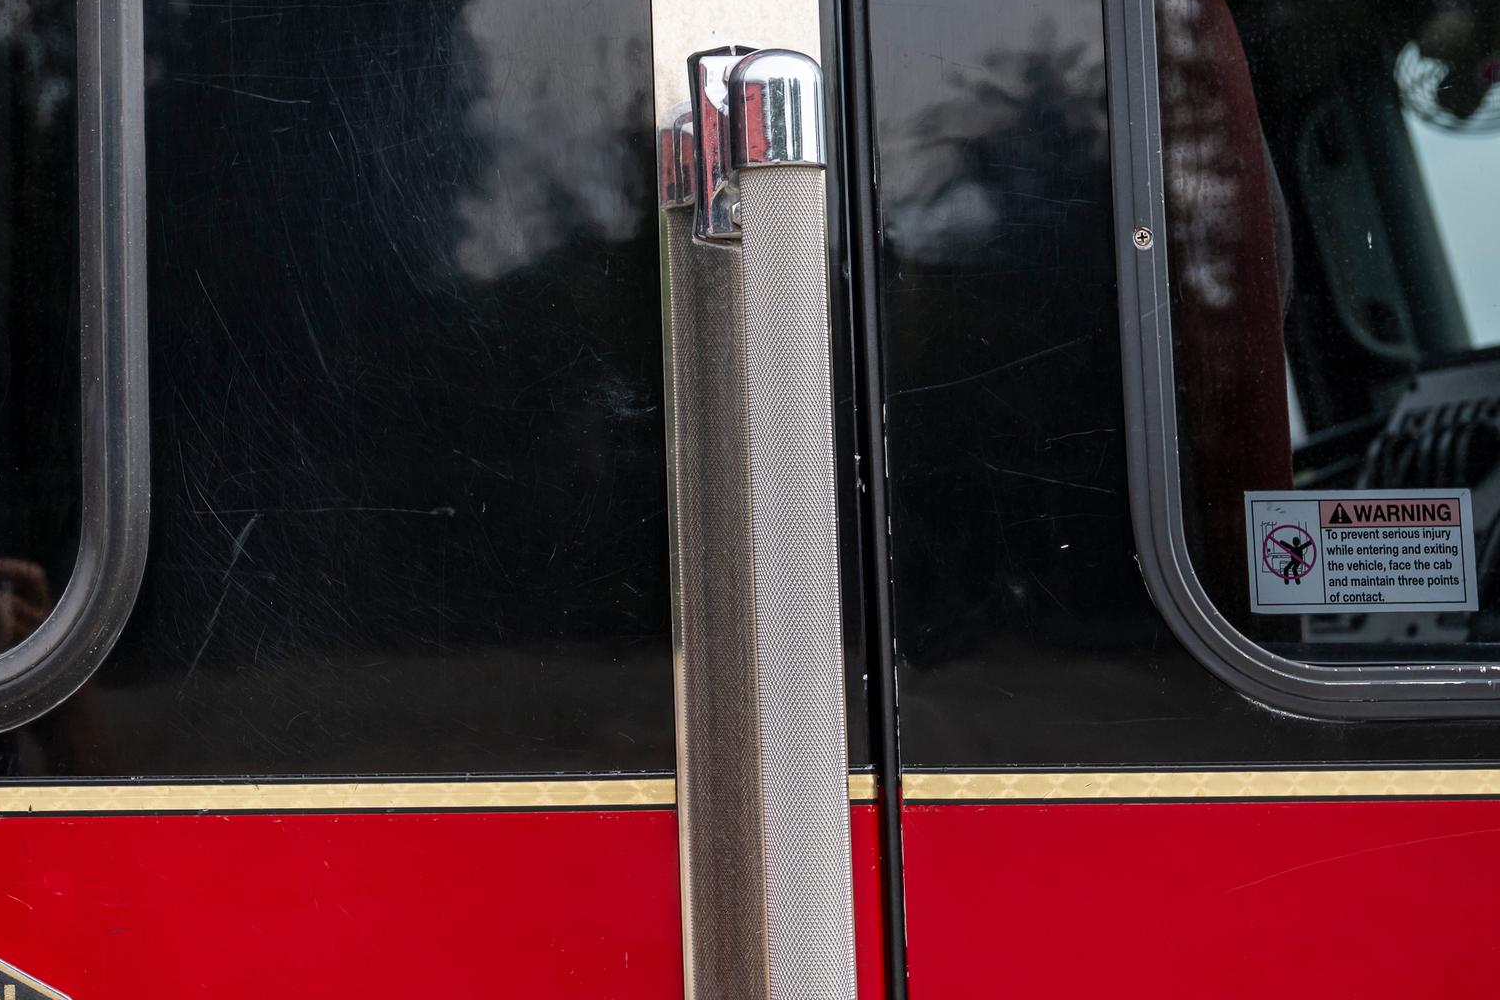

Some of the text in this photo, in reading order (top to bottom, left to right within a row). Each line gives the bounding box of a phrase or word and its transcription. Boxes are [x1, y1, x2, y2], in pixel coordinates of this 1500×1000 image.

[1353, 504, 1451, 522] WARNING
[1326, 528, 1451, 543] To prevent serious injury
[1327, 544, 1458, 558] while entering and exiting
[1328, 560, 1452, 572] the vehicle, face the cab
[1329, 575, 1459, 588] and maintain three points
[1330, 592, 1385, 603] of contact.
